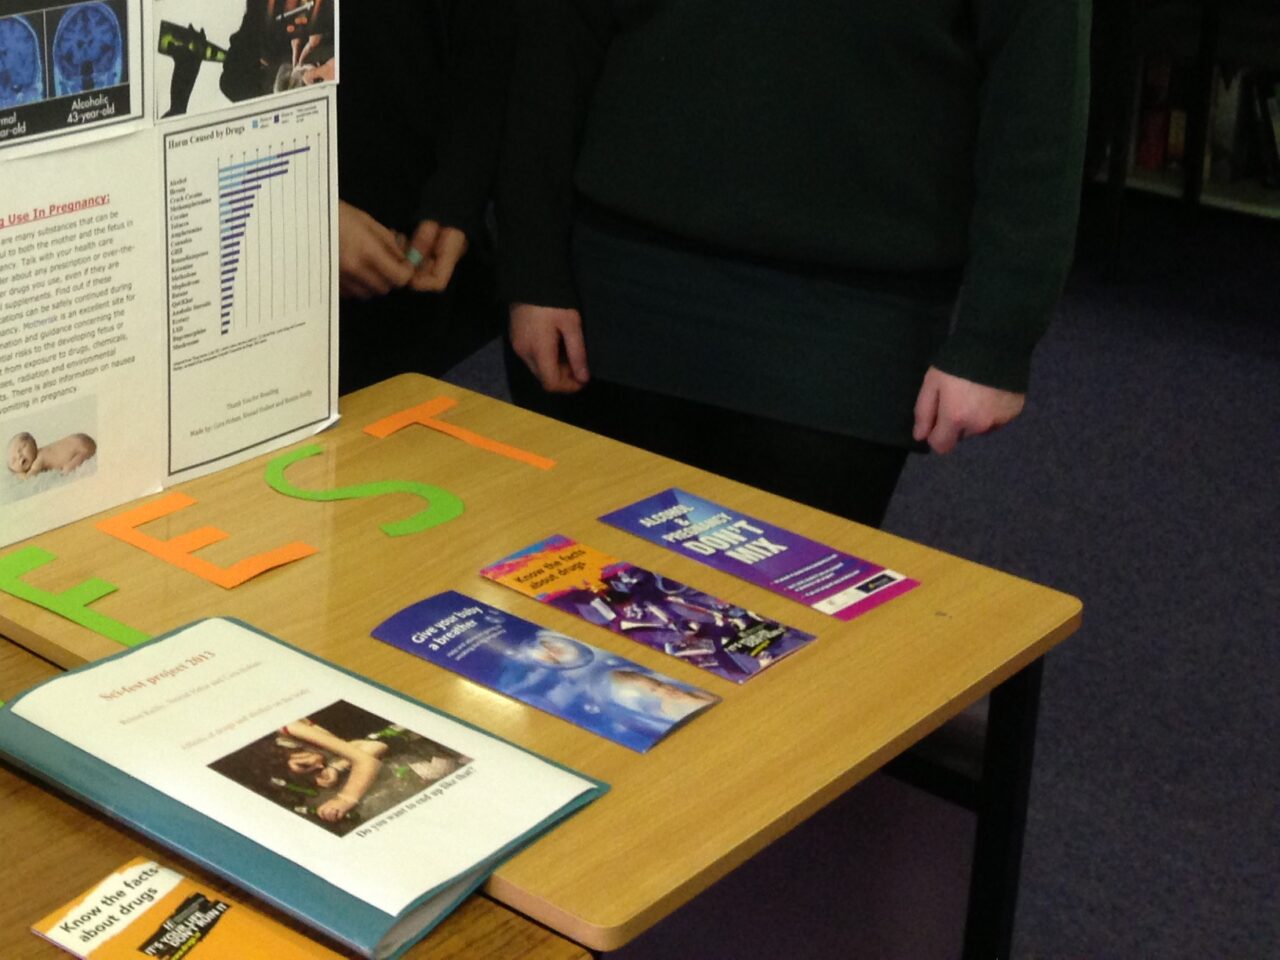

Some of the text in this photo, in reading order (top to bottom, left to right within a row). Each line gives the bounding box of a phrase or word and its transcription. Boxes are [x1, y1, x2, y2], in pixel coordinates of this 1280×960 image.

[67, 104, 115, 124] 43-year-old
[71, 94, 109, 111] Alcoholic
[190, 132, 214, 145] Caused
[225, 125, 245, 138] Drugs
[8, 213, 30, 227] Use
[48, 194, 110, 216] Pregnancy:
[37, 222, 77, 236] substances
[79, 217, 93, 226] that
[95, 214, 108, 222] can
[37, 241, 49, 249] the
[51, 234, 76, 245] mother
[79, 229, 92, 239] and
[94, 227, 105, 235] the
[108, 223, 125, 232] fetus
[21, 241, 96, 266] Talk with health
[11, 270, 32, 282] about
[93, 276, 111, 286] these
[9, 285, 30, 295] drugs
[74, 288, 108, 303] continued
[110, 283, 132, 294] during
[15, 348, 32, 358] risks
[58, 331, 95, 346] developing
[97, 326, 114, 334] fetus
[40, 325, 72, 340] guidance
[24, 354, 57, 368] exposure
[12, 387, 32, 397] There
[43, 379, 57, 389] also
[59, 367, 98, 383] information
[111, 356, 135, 367] nausea
[18, 369, 49, 382] radiation
[639, 504, 694, 528] ALCOHOL
[661, 512, 732, 543] PREGNANCY
[682, 520, 764, 556] DON'T
[724, 537, 788, 565] MIX
[514, 550, 586, 583] Know the facts
[531, 562, 586, 589] about drugs
[411, 626, 438, 644] Give
[434, 615, 459, 631] your
[452, 606, 484, 619] baby
[432, 619, 478, 645] breather
[428, 642, 440, 651] a
[147, 663, 189, 685] project
[185, 650, 216, 667] 2013
[356, 779, 458, 838] Do you want to end up like
[59, 867, 159, 933] Know the facts
[78, 915, 119, 943] about
[120, 887, 158, 916] drugs
